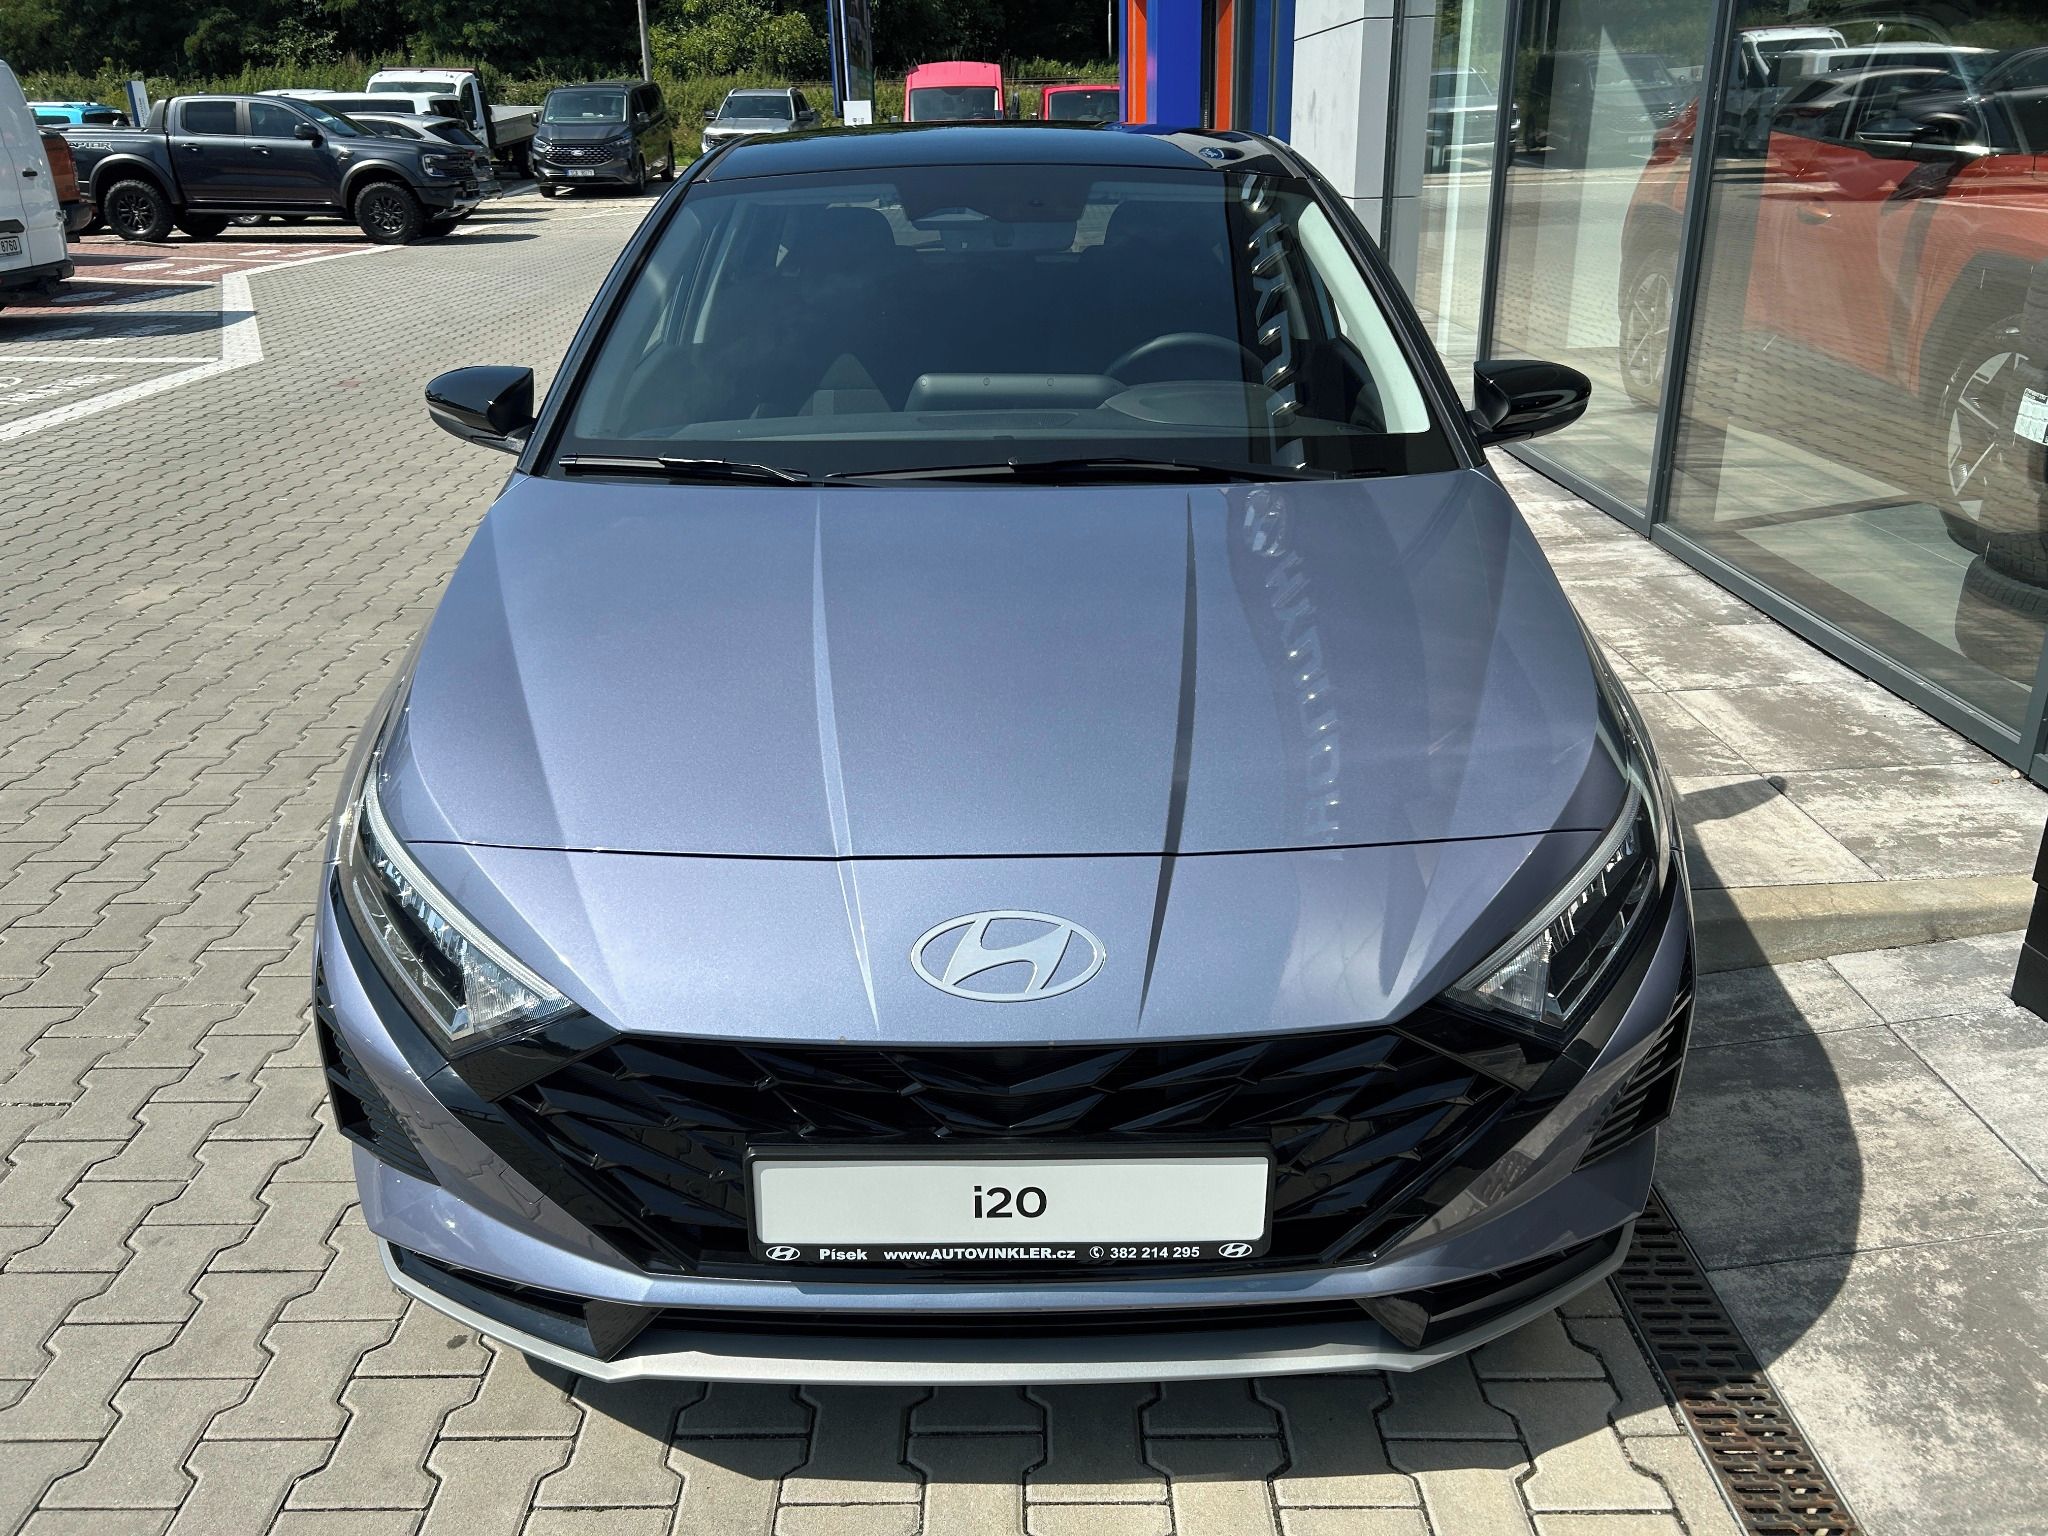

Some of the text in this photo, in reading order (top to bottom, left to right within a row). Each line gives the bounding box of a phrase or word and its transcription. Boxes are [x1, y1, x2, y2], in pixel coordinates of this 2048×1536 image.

[67, 141, 115, 152] APTOR
[973, 1185, 1047, 1219] i20
[819, 1245, 1200, 1261] Písek www.AUTOVINKLER.cz 382 214 295
